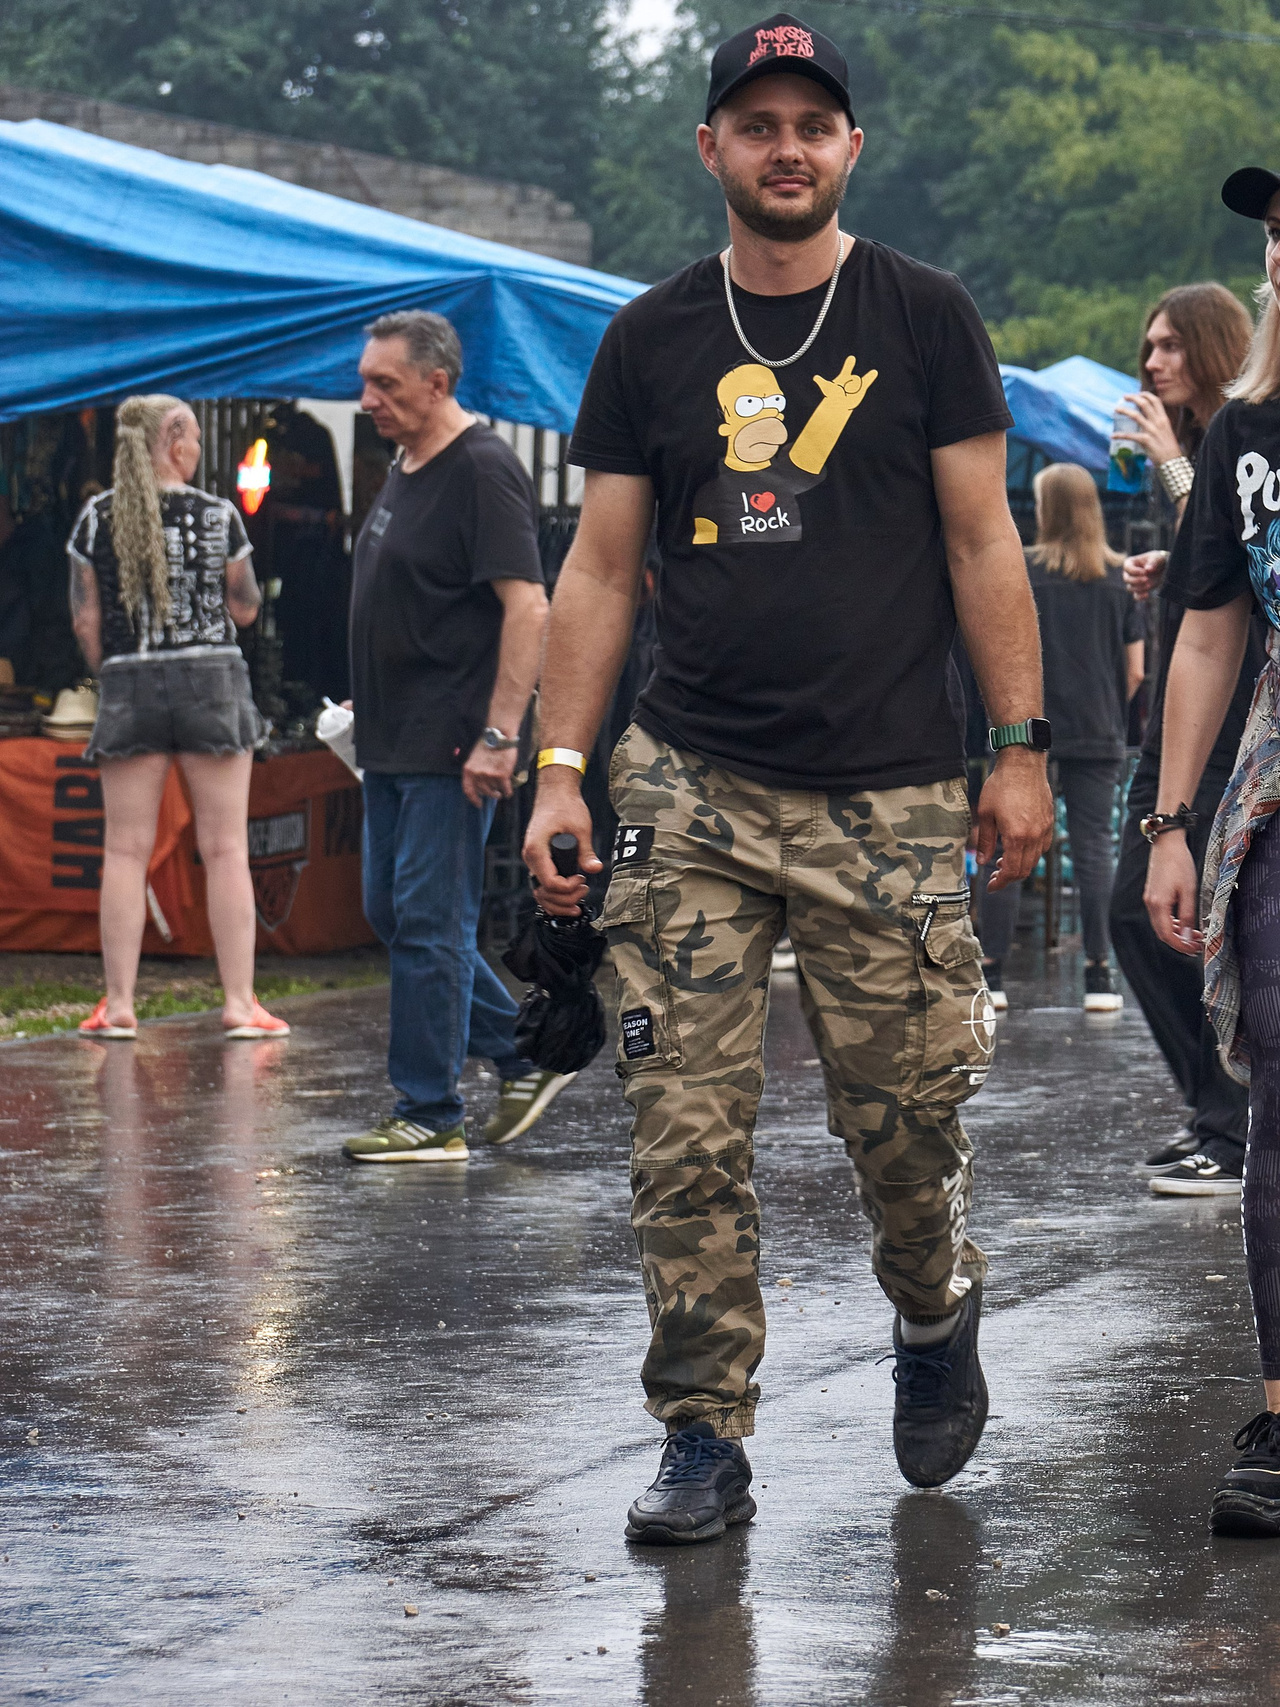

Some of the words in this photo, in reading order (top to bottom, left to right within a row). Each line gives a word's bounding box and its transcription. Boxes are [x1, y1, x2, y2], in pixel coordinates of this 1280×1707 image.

[772, 41, 815, 58] DEAD
[741, 492, 749, 513] I
[739, 507, 790, 534] Rock
